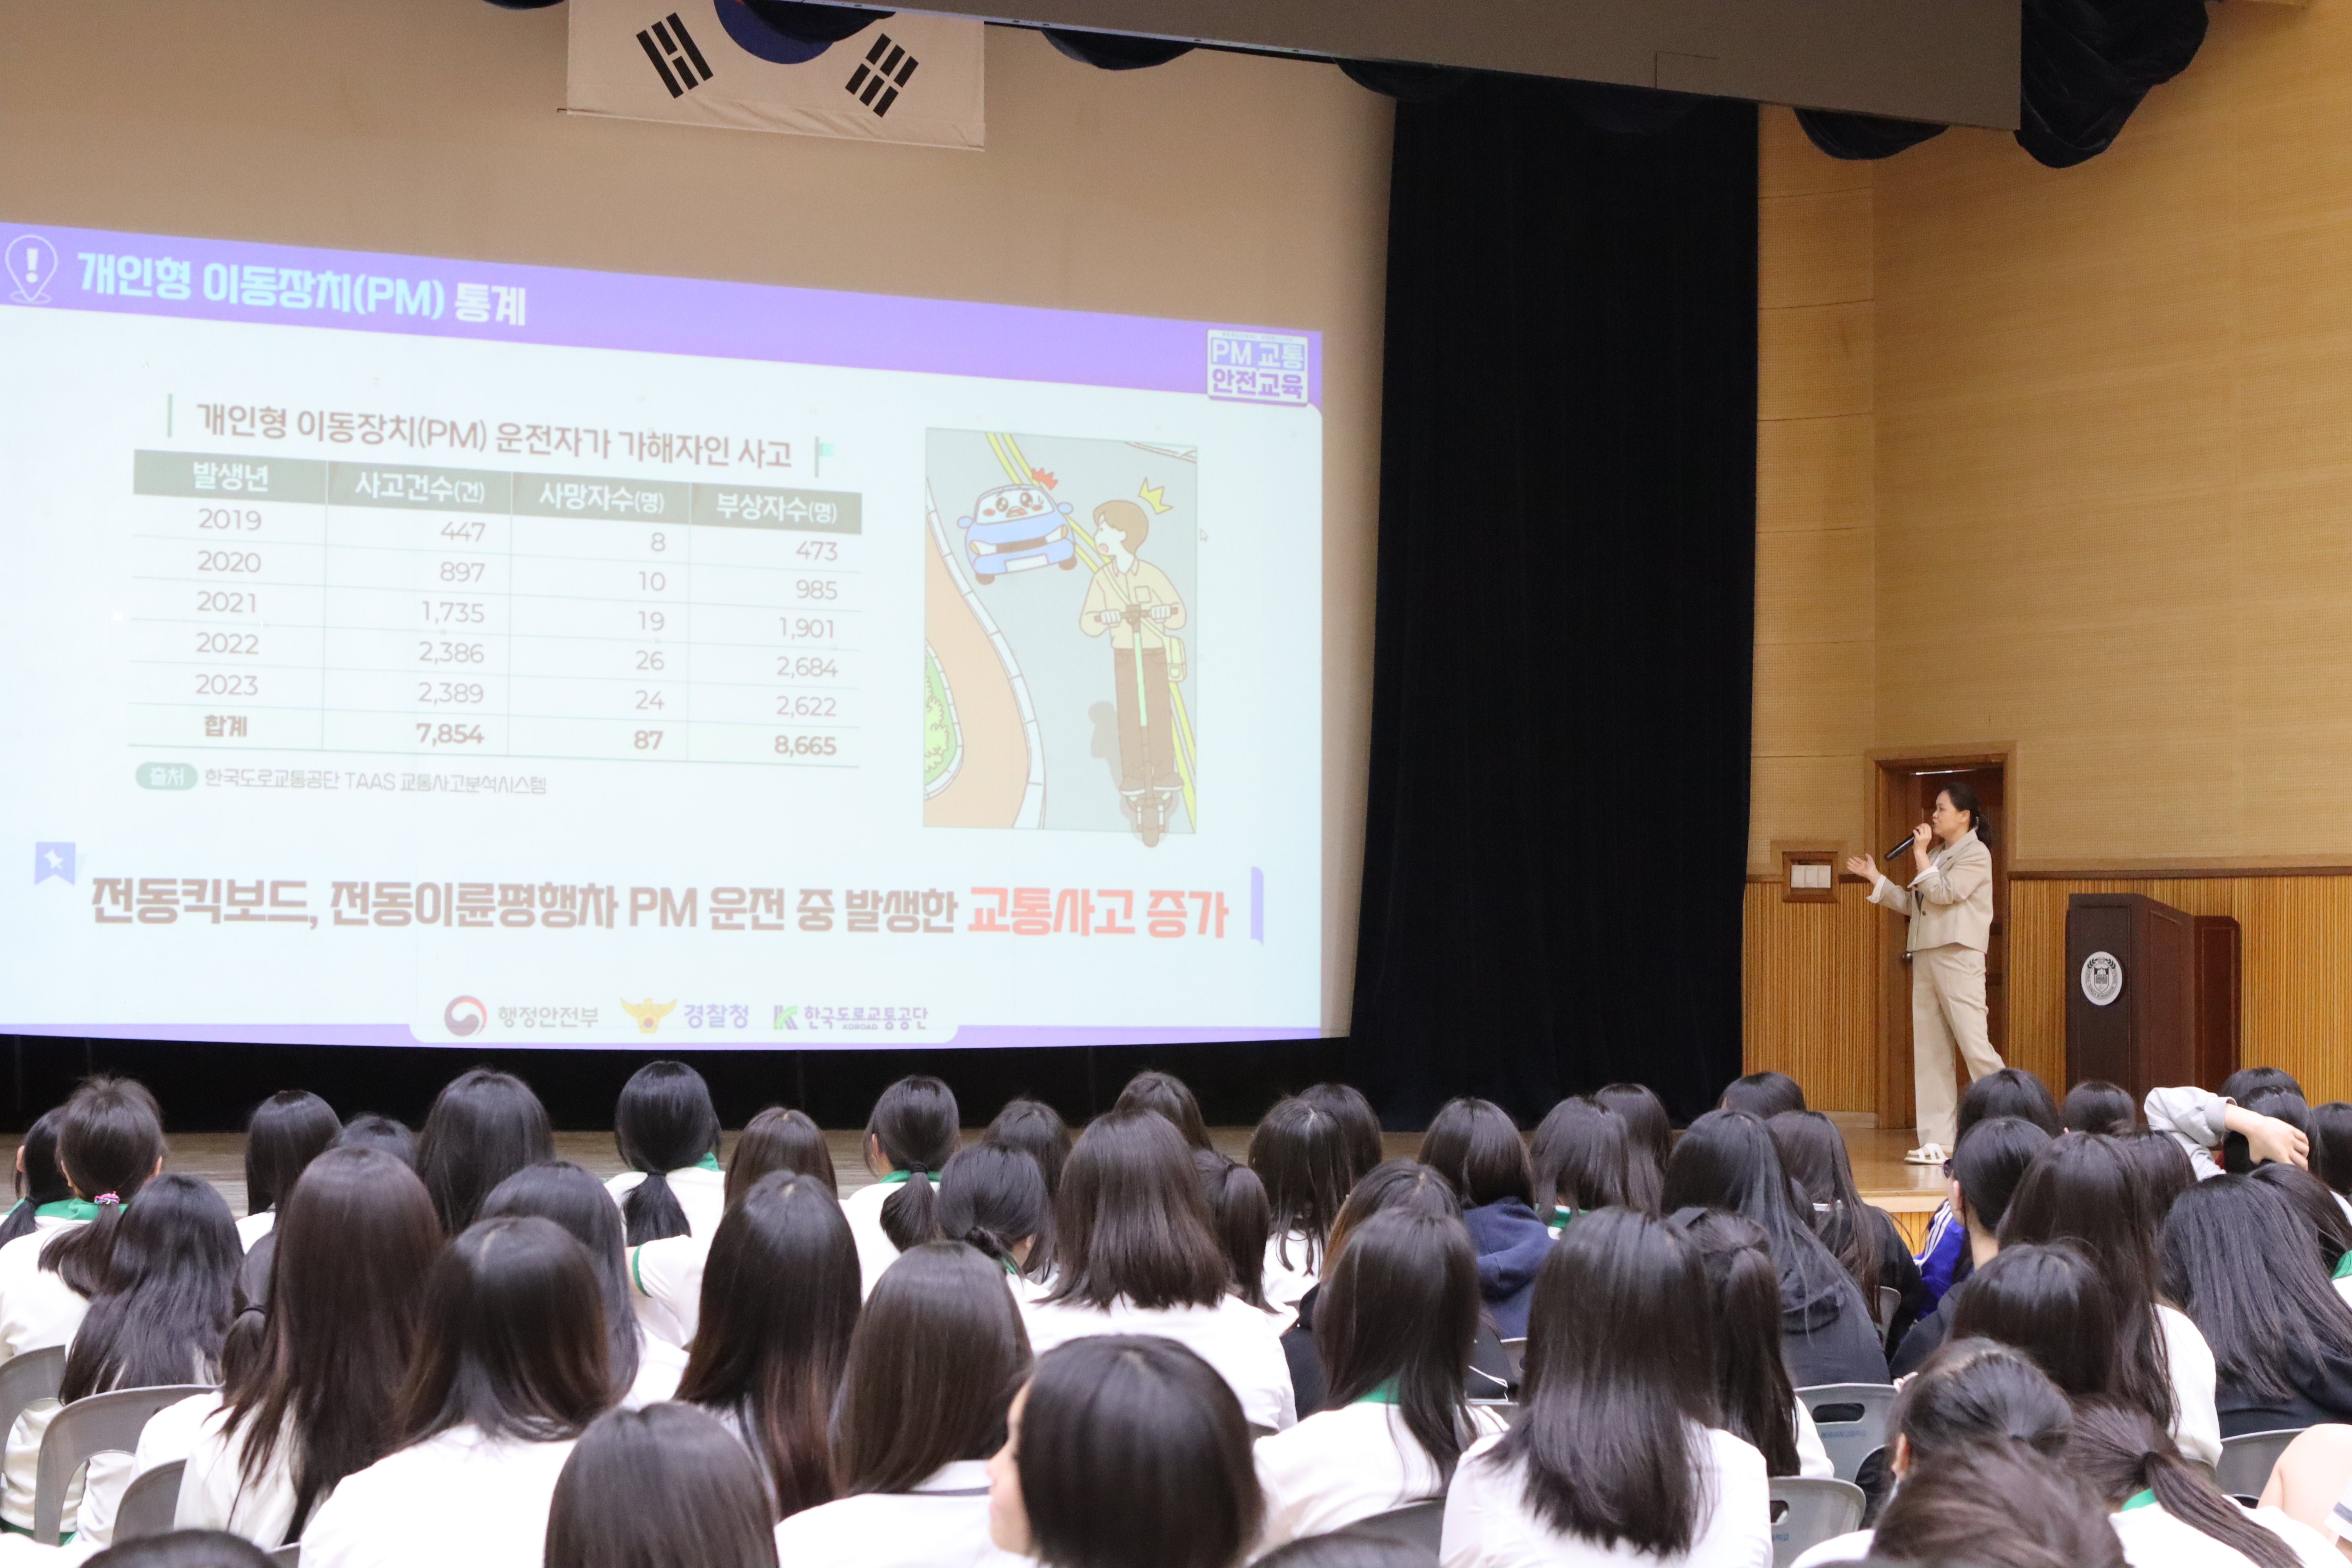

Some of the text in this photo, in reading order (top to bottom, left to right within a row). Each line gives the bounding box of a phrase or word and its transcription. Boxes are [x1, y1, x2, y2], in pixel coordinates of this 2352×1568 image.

[77, 252, 526, 326] 개인형 이동장치(PM) 통계
[1212, 339, 1303, 369] PM 교통
[1212, 369, 1303, 399] 안전교육
[197, 403, 792, 468] 개인형 이동장치(PM) 운전자가 가해자인 사고
[193, 461, 837, 524] 발생년 사고건수(건) 사망자수(명) 부상자수(명)
[198, 508, 838, 561] 2019 447 8 473
[198, 550, 838, 600] 2020 897 10 985
[197, 590, 834, 640] 2021 1,735 19 1,901
[196, 632, 838, 679] 2022 2,386 26 2,684
[195, 674, 837, 718] 2023 2,389 24 2,622
[205, 715, 837, 758] 합계 7,854 87 8,665
[205, 768, 339, 789] 한국도로교통공단
[346, 772, 396, 791] TAAS
[400, 773, 546, 795] 교통사고분석시스템
[91, 877, 1229, 939] 전동킥보드, 전동이륜평행차 PM 운전 중 발생한 교통사고 증가
[498, 1006, 599, 1029] 행정안전부
[684, 1004, 749, 1029] 경찰청
[804, 1004, 929, 1031] 한국도로교통공단
